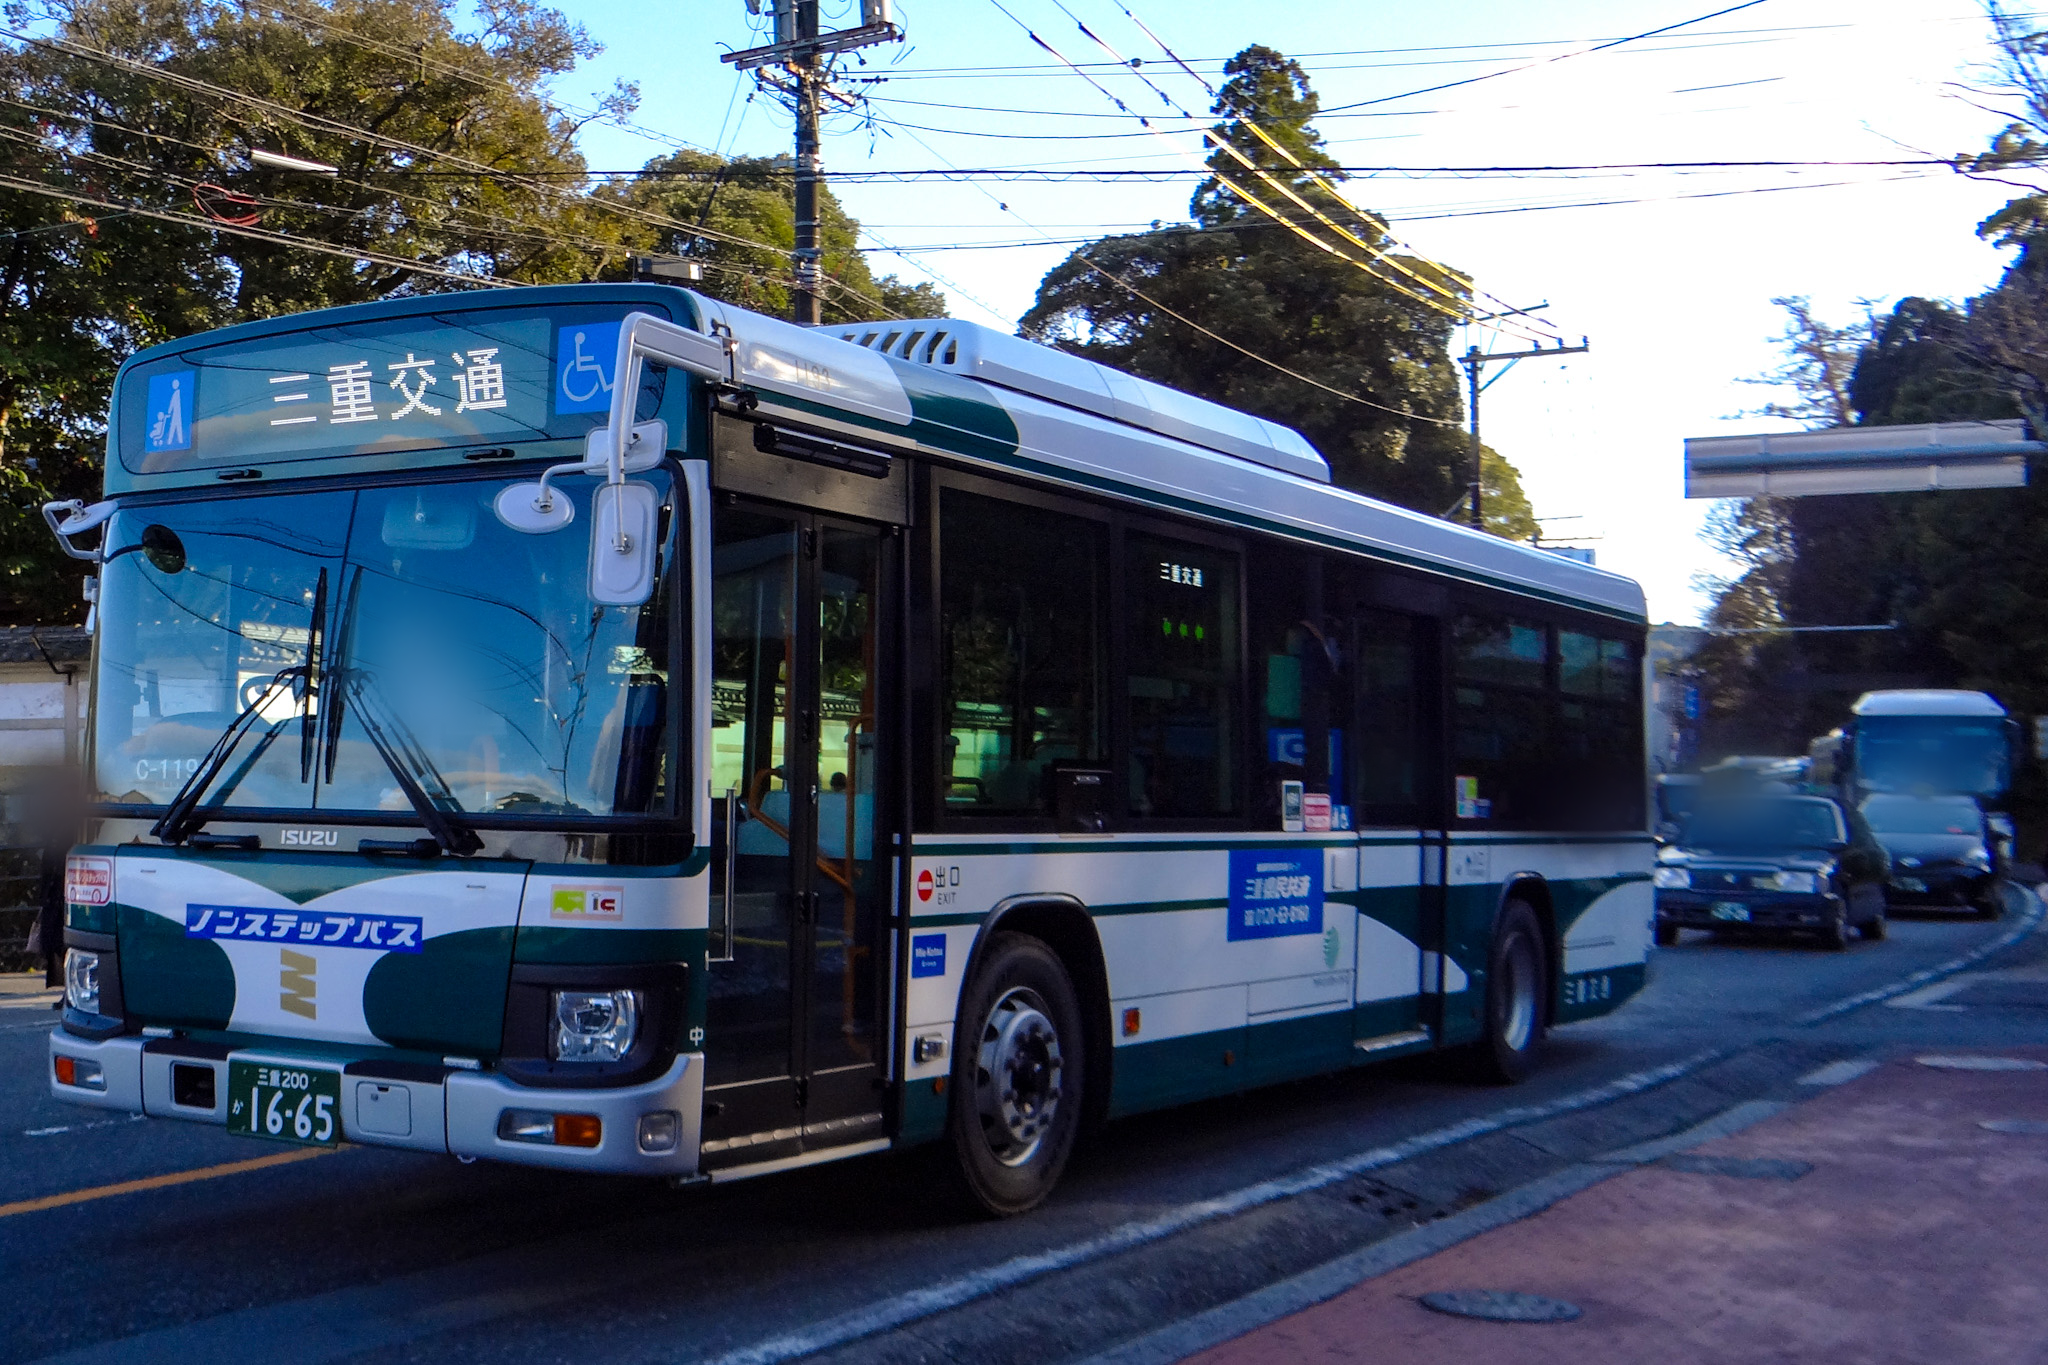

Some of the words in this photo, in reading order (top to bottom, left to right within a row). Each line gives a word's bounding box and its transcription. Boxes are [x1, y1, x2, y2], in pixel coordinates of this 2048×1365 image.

[269, 348, 507, 426] 三重交通
[1160, 562, 1203, 588] 三重交通
[280, 829, 338, 847] ISUZU
[935, 866, 960, 888] 出口
[937, 892, 957, 905] EXIT
[189, 909, 419, 947] ノンステップバス
[690, 1025, 704, 1046] 中
[251, 1086, 334, 1141] 16-65
